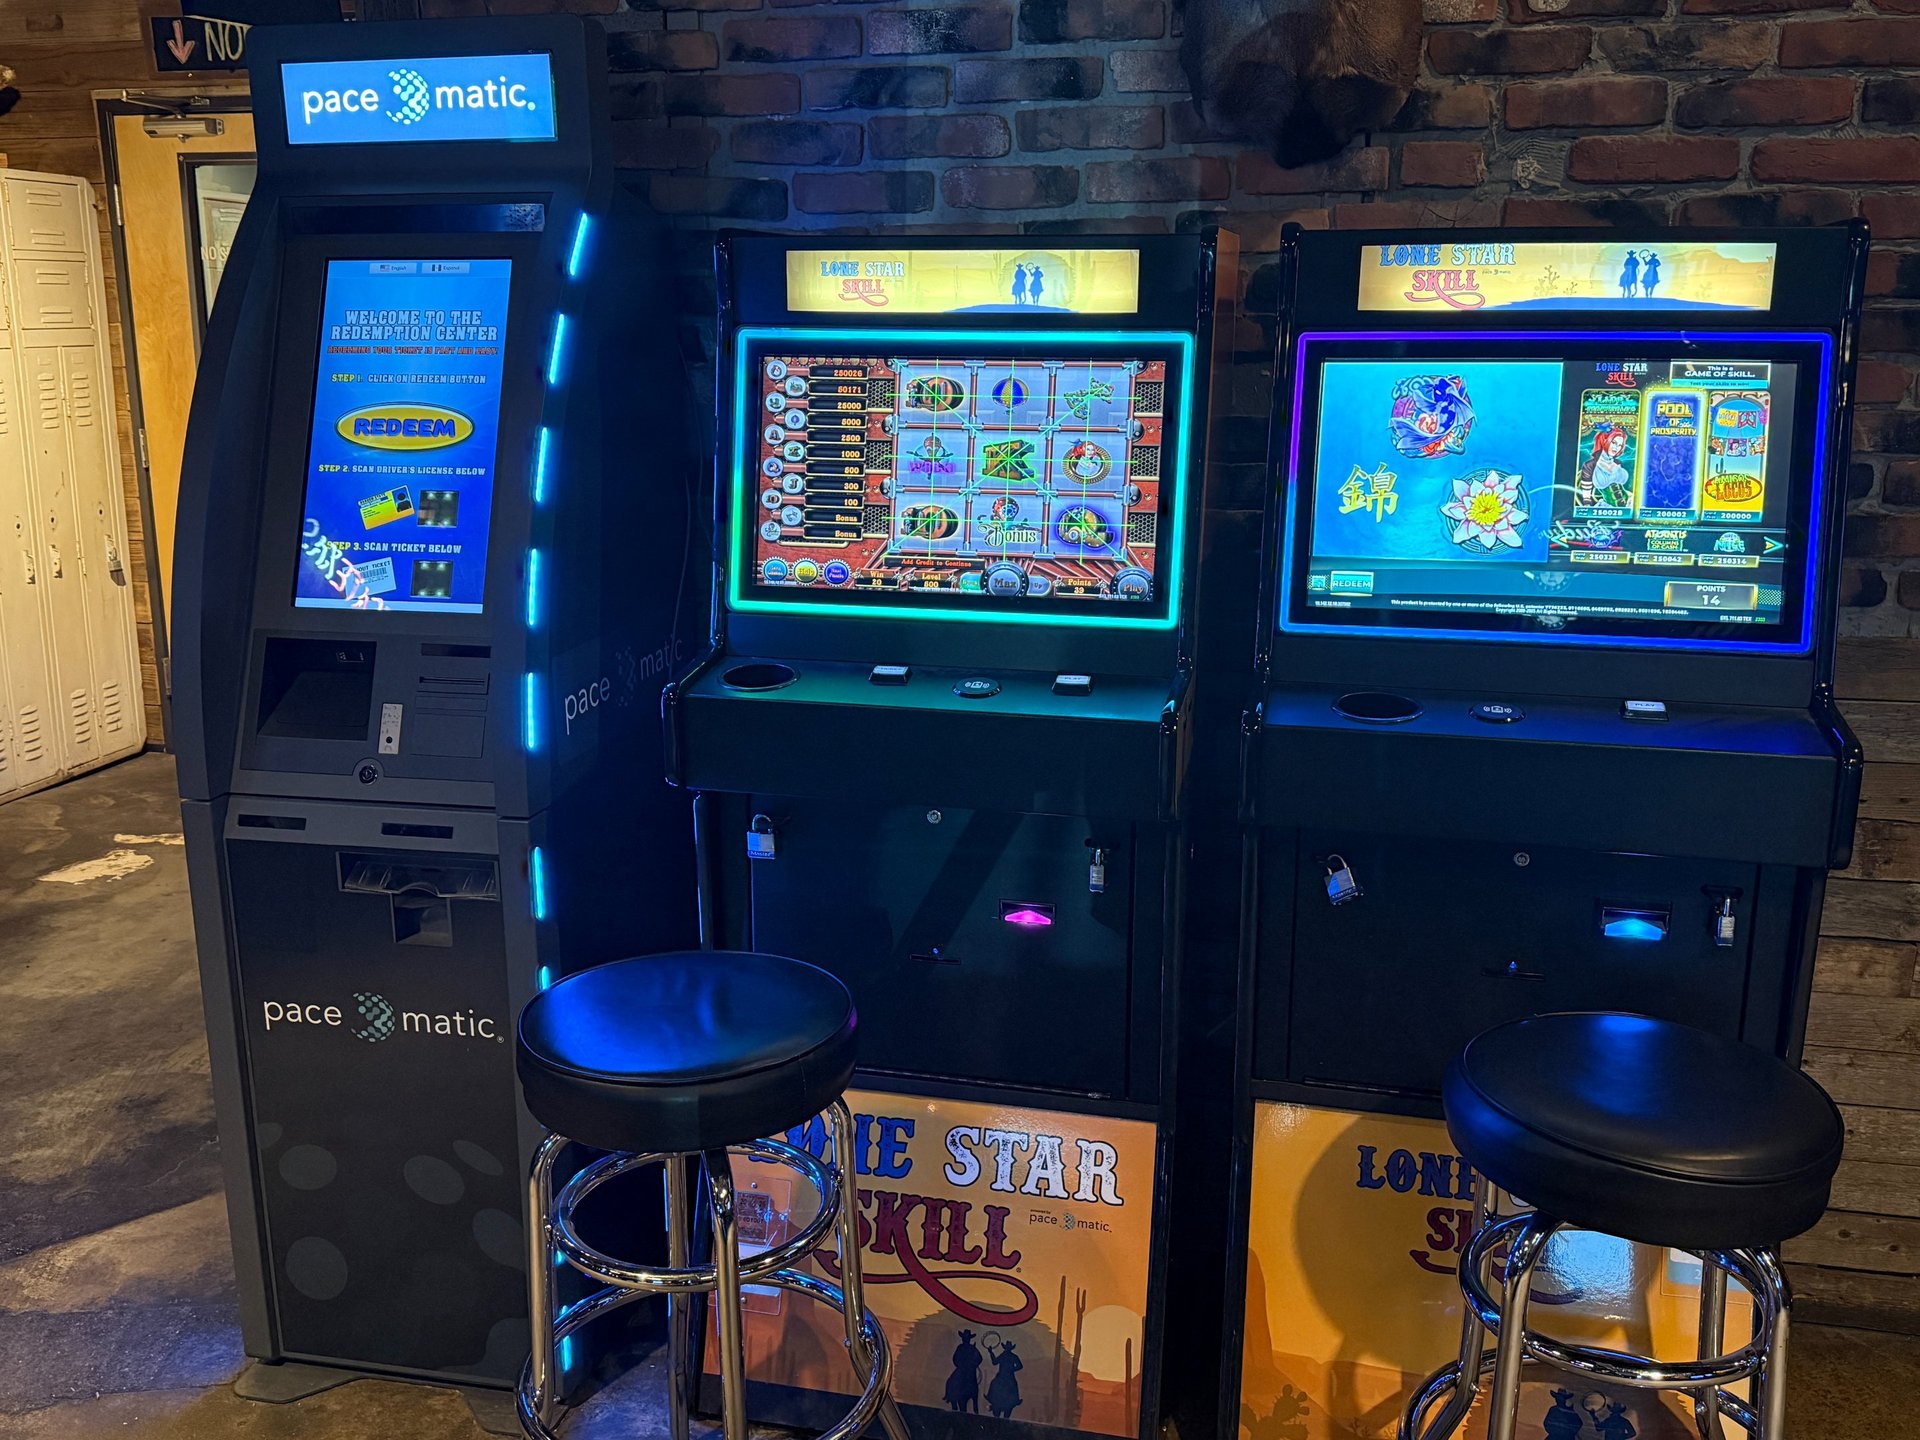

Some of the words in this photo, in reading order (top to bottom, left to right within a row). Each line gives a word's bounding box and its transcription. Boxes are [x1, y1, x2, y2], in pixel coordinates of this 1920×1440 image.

[303, 86, 379, 124] pace
[1380, 243, 1441, 267] LONE
[1451, 243, 1517, 266] STAR
[820, 260, 860, 277] LONE
[864, 260, 906, 278] STAR
[345, 310, 421, 325] WELCOME
[425, 310, 446, 325] TO
[451, 310, 482, 325] THE
[330, 325, 431, 341] REDEMPTION
[435, 326, 499, 341] CENTER
[1595, 362, 1621, 372] LONE
[1622, 362, 1648, 372] STAR
[331, 373, 355, 382] STEP
[367, 374, 394, 383] CLICK
[396, 374, 408, 383] ON
[410, 375, 448, 384] REDEEM
[450, 375, 487, 384] BUTTON
[1656, 403, 1694, 418] POOL
[1669, 417, 1680, 427] OF
[353, 418, 456, 438] REDEEM
[1650, 427, 1697, 436] PROSPERITY
[841, 450, 860, 458] 1000
[318, 464, 341, 473] STEP
[352, 465, 375, 473] SCAN
[376, 465, 416, 474] DRIVER'S
[417, 466, 454, 475] LICENSE
[455, 467, 486, 476] BELOW
[1338, 462, 1399, 523] 錦
[844, 498, 859, 506] 100
[835, 514, 858, 522] Bonus
[834, 530, 857, 538] Bonus
[976, 522, 1038, 547] Bonus
[1644, 529, 1688, 539] ATLANTIS
[353, 542, 362, 551] 3.
[363, 542, 389, 552] SCAN
[391, 543, 427, 553] TICKET
[428, 544, 462, 554] BELOW
[797, 568, 815, 576] Help
[871, 578, 882, 586] 20
[994, 578, 1017, 588] Max
[1067, 579, 1092, 587] Points
[1332, 579, 1371, 588] REDEEM
[1123, 584, 1144, 593] Play
[1696, 585, 1727, 593] POINTS
[1702, 595, 1721, 606] 14
[564, 676, 610, 736] pace
[263, 1000, 343, 1031] pace
[943, 1124, 1125, 1206] STAR
[1029, 1214, 1058, 1225] pace
